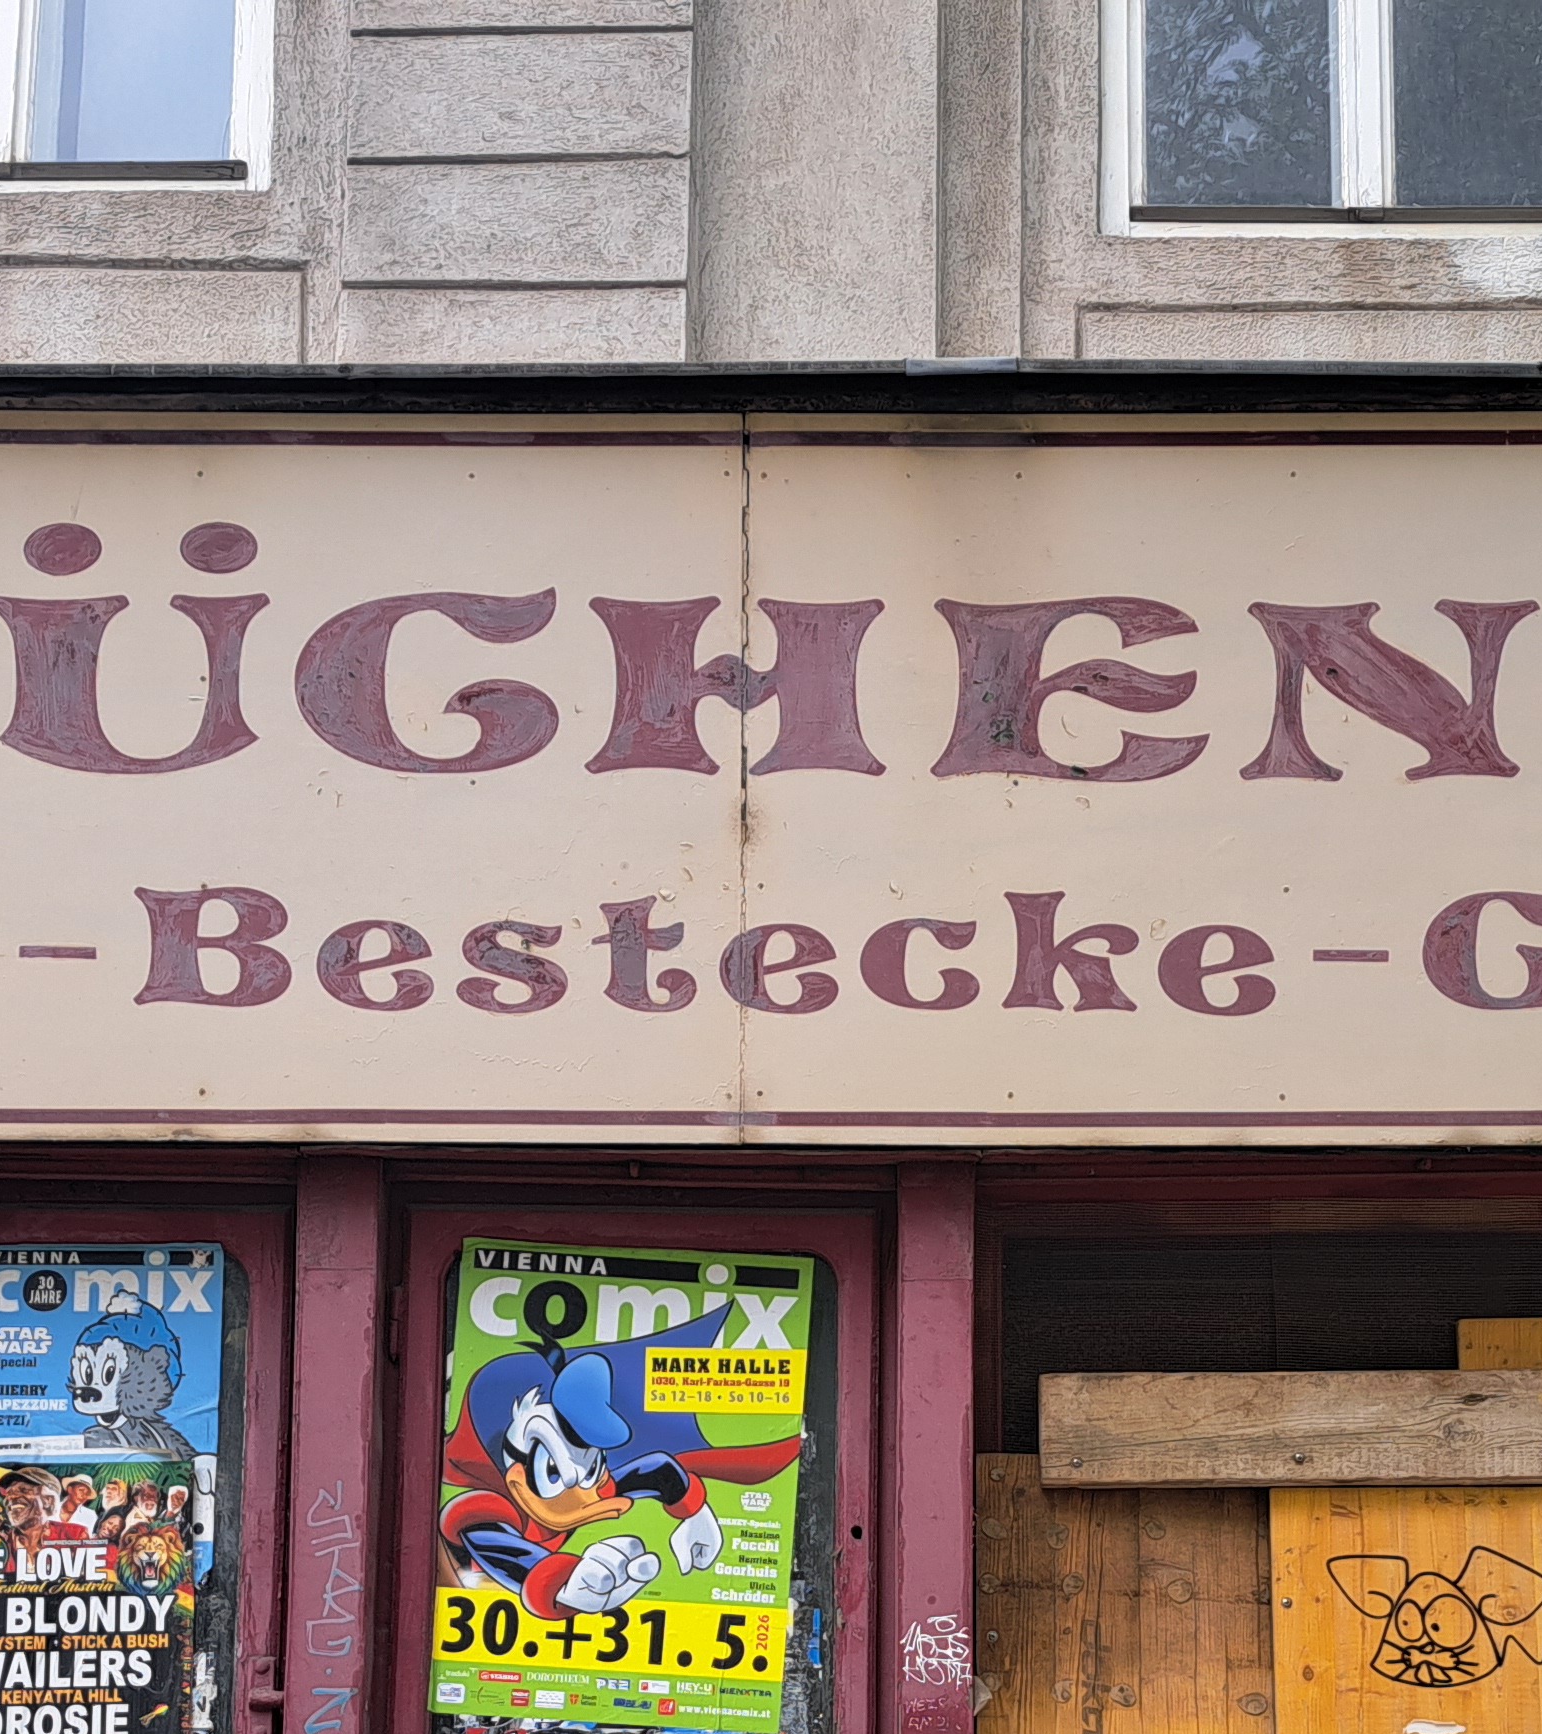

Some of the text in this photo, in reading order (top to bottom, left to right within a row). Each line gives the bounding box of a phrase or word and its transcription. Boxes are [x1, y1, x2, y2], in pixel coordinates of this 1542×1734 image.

[477, 1249, 608, 1275] VIENNA
[37, 1277, 55, 1289] 30
[29, 1289, 62, 1304] JAHRE
[469, 1263, 799, 1350] comix
[652, 1357, 791, 1374] MARX HALLE
[16, 1547, 108, 1580] LOVE
[5, 1596, 175, 1635] BLONDY
[756, 1614, 769, 1650] 2026
[1, 1689, 84, 1705] KENYATTA
[87, 1688, 122, 1703] HILL
